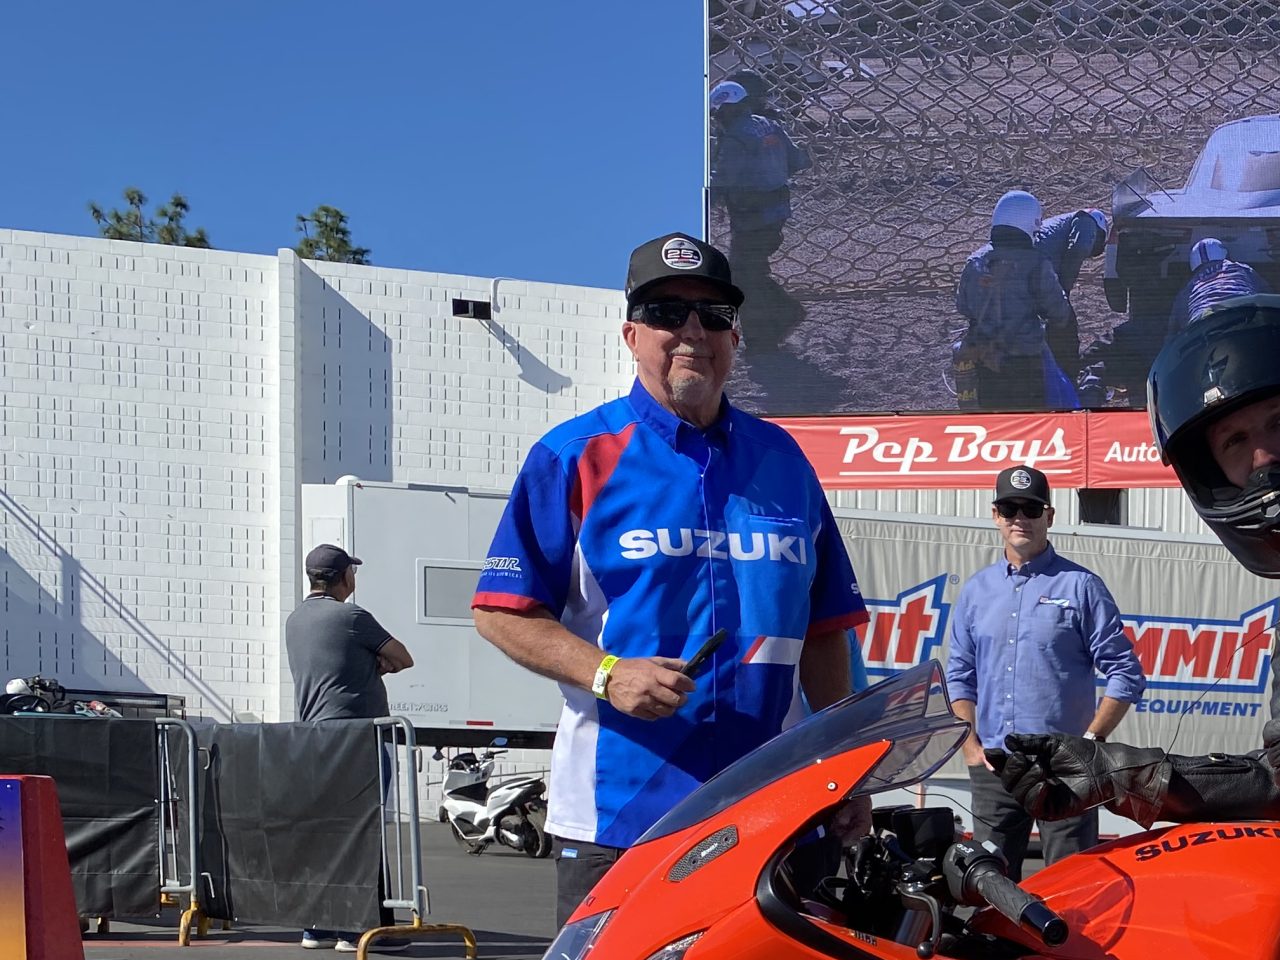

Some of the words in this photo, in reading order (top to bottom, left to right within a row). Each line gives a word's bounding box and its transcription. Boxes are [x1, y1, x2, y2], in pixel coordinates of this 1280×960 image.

[839, 427, 937, 473] Pep
[944, 425, 1072, 468] Boys
[619, 528, 807, 565] SUZUKI
[1135, 699, 1262, 717] EQUIPMENT
